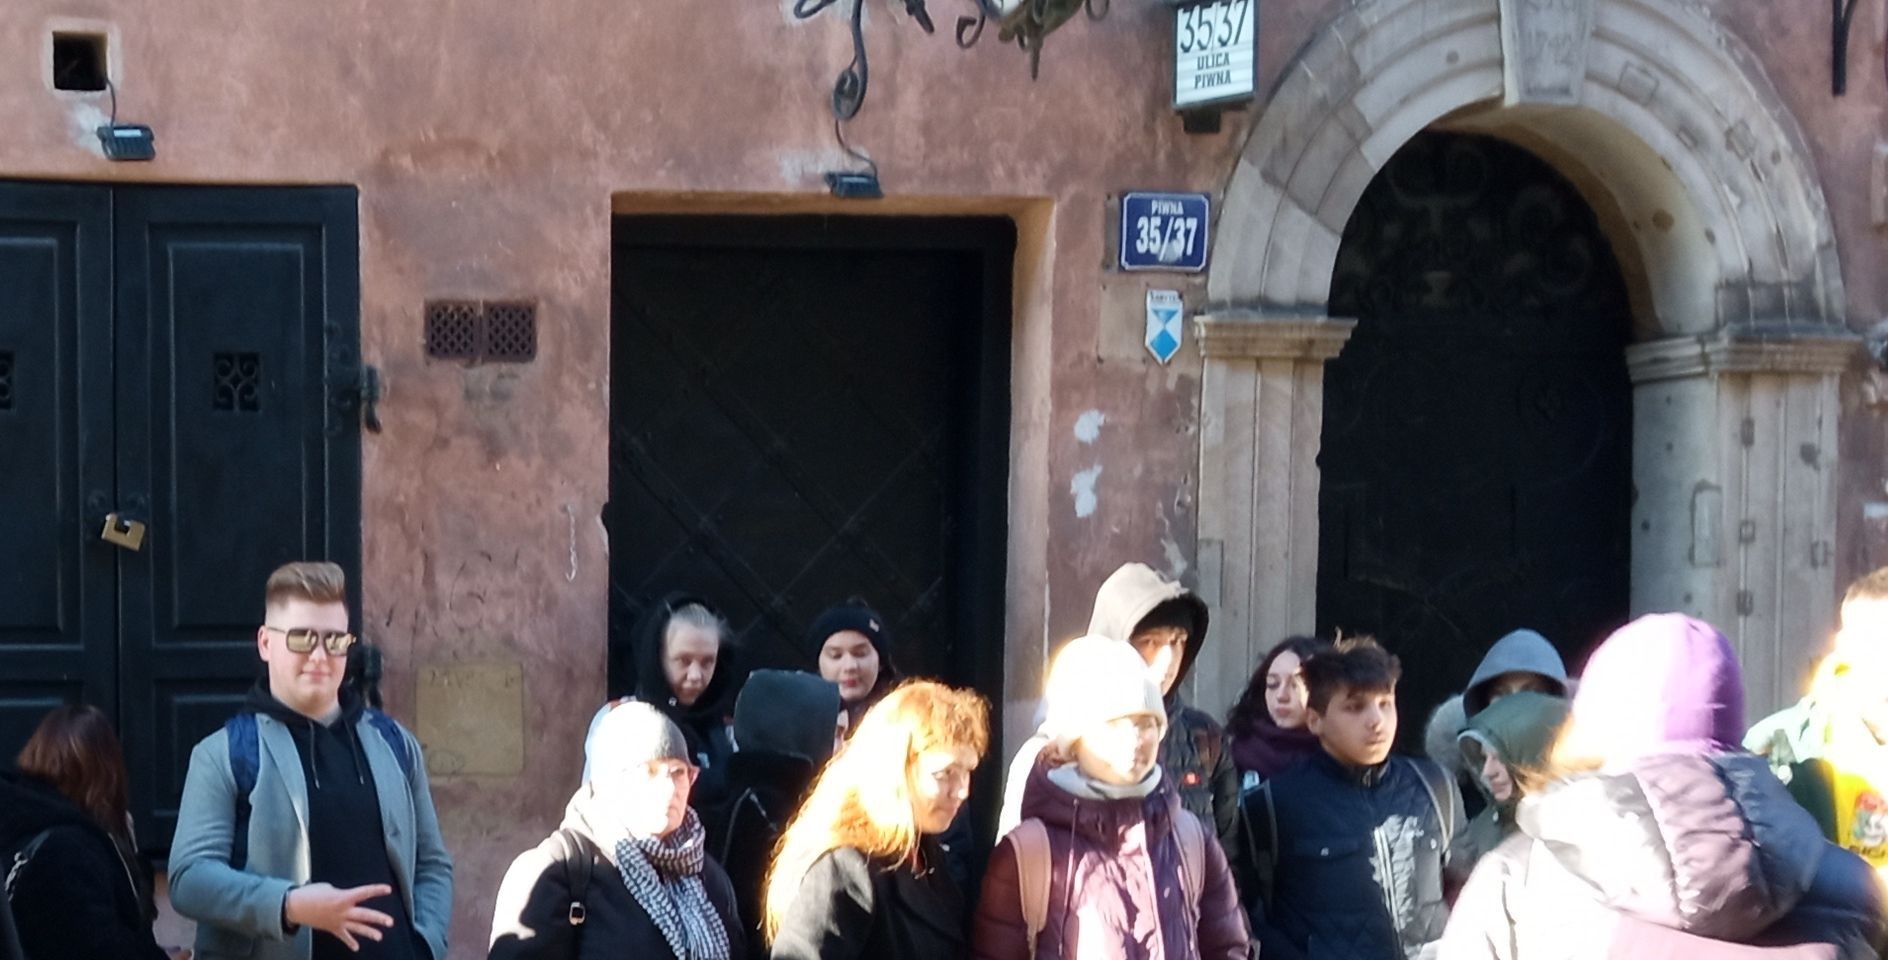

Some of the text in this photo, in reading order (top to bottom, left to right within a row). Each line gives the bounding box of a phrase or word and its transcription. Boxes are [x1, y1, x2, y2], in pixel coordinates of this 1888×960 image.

[1197, 52, 1230, 71] ULICA
[1194, 70, 1231, 89] PIWNA
[1152, 200, 1184, 215] PIWNA
[1135, 216, 1198, 262] 35/37
